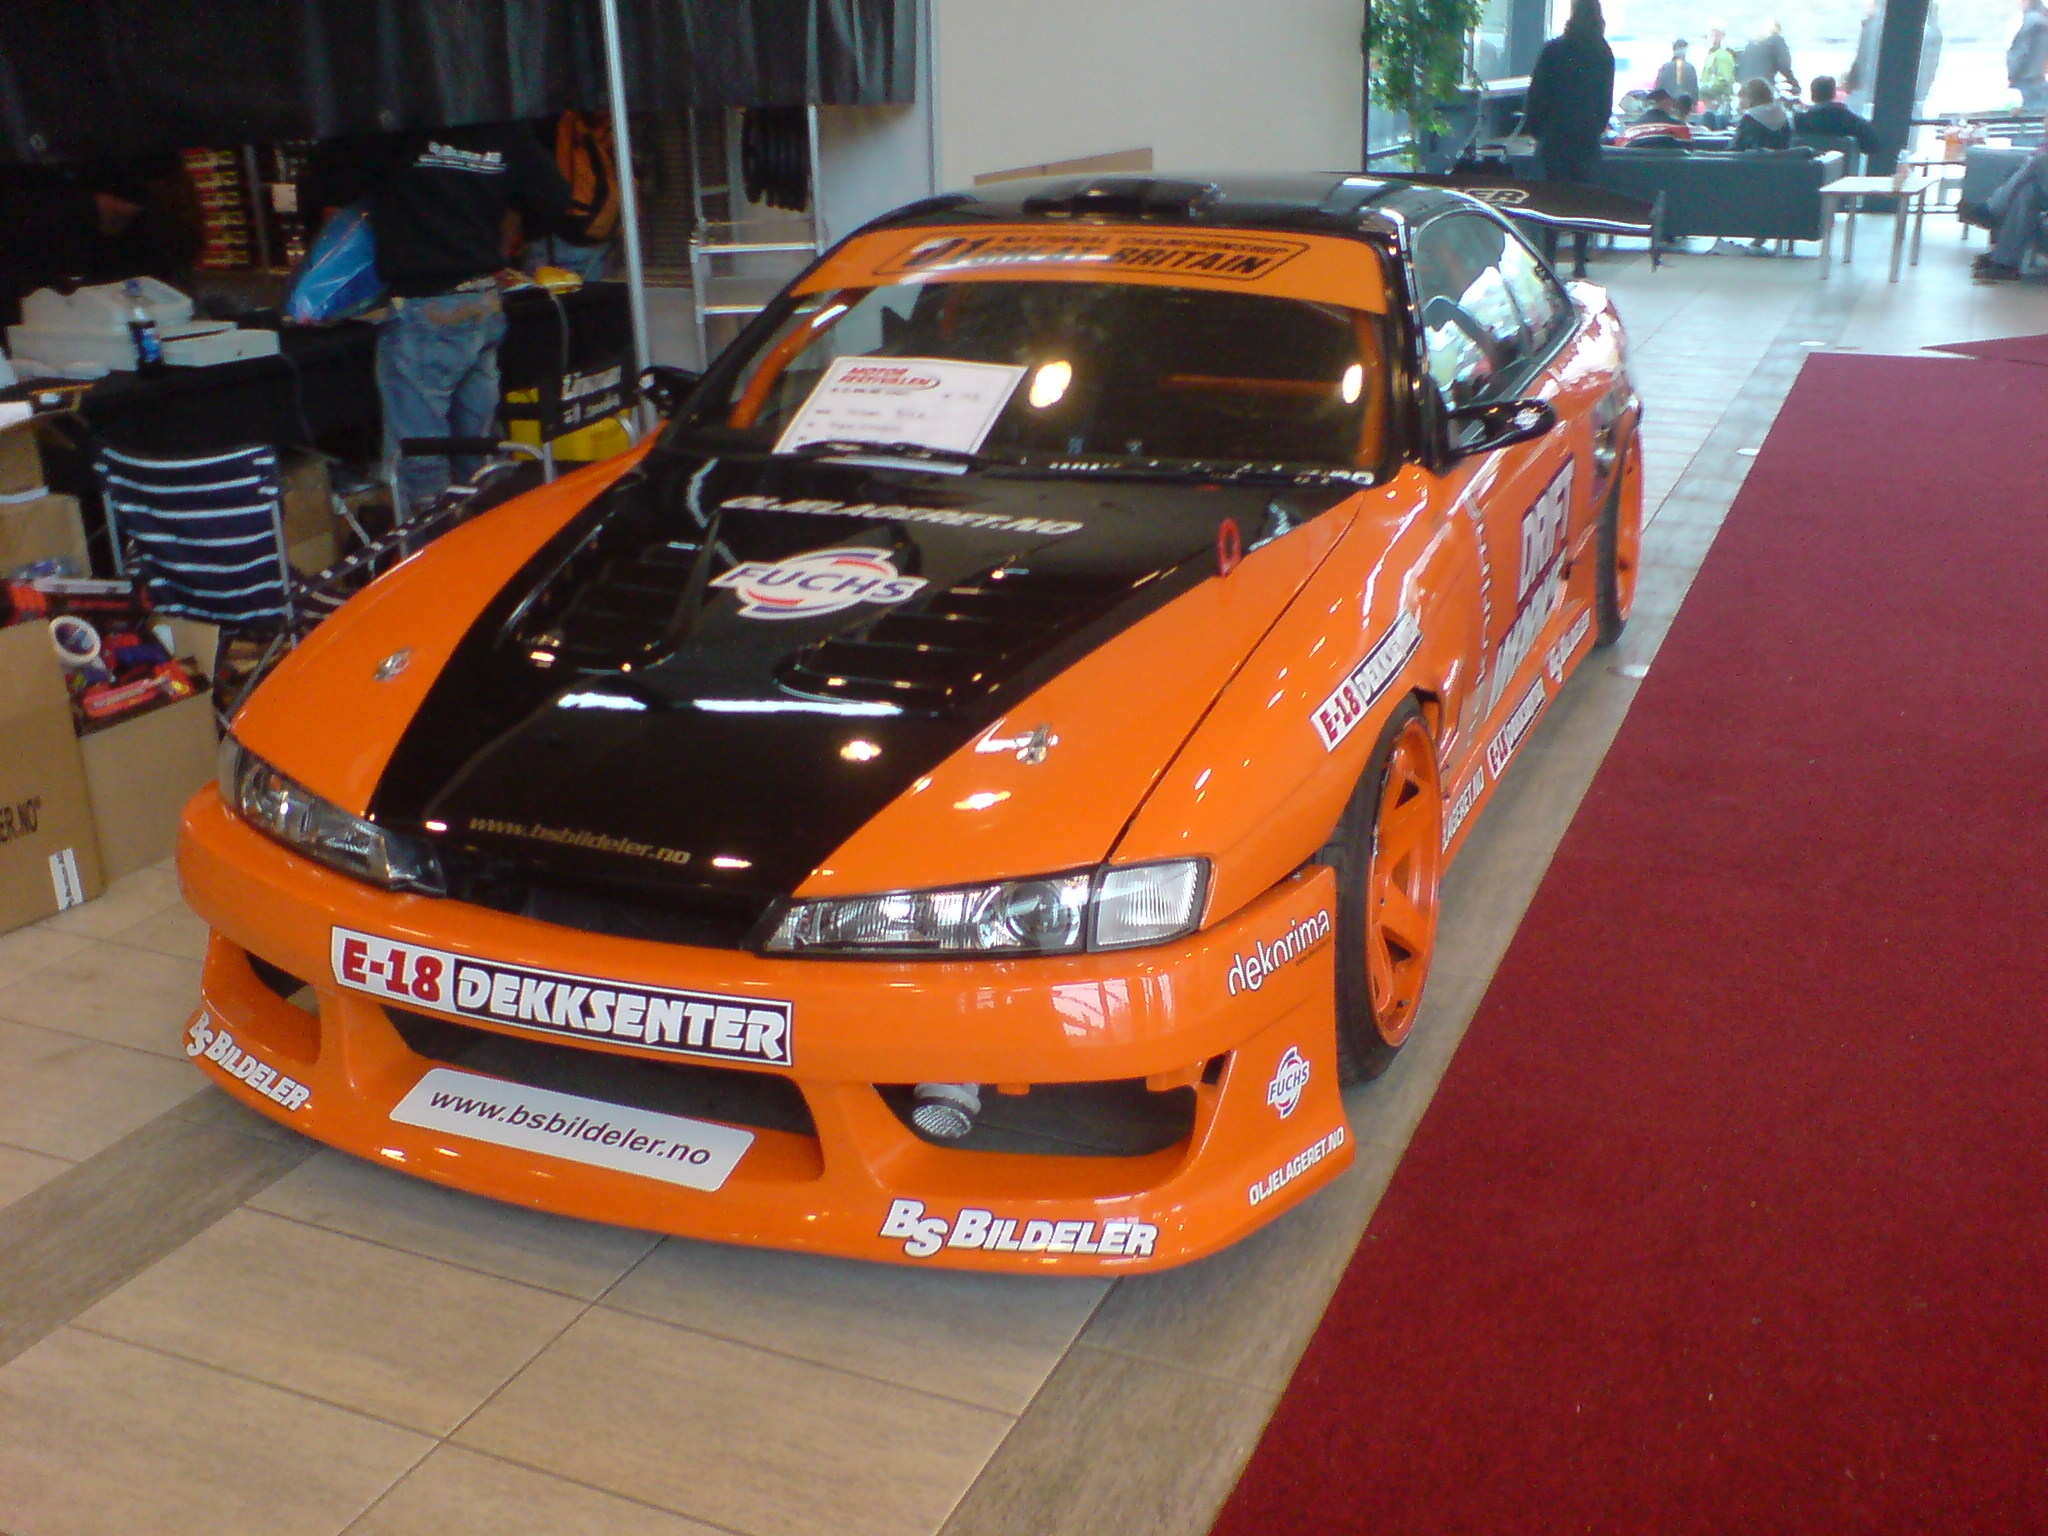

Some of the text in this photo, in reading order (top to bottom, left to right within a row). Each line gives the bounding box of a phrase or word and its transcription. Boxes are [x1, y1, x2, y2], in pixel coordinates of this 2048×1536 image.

[1108, 247, 1273, 275] BRITAIN
[724, 565, 917, 600] FUCHS
[1320, 686, 1361, 743] E-18
[468, 818, 691, 865] www.bsbildeler.no
[1228, 909, 1331, 996] dekorima
[342, 937, 786, 1060] E-18 DEKKSENTER
[186, 1010, 311, 1112] BS BILDELER
[1269, 1060, 1309, 1101] FUCHS
[430, 1089, 711, 1167] www.bsbildeler.no
[1249, 1126, 1345, 1206] OLJELAGERET.NO
[880, 1198, 1159, 1258] BS BILDELER
